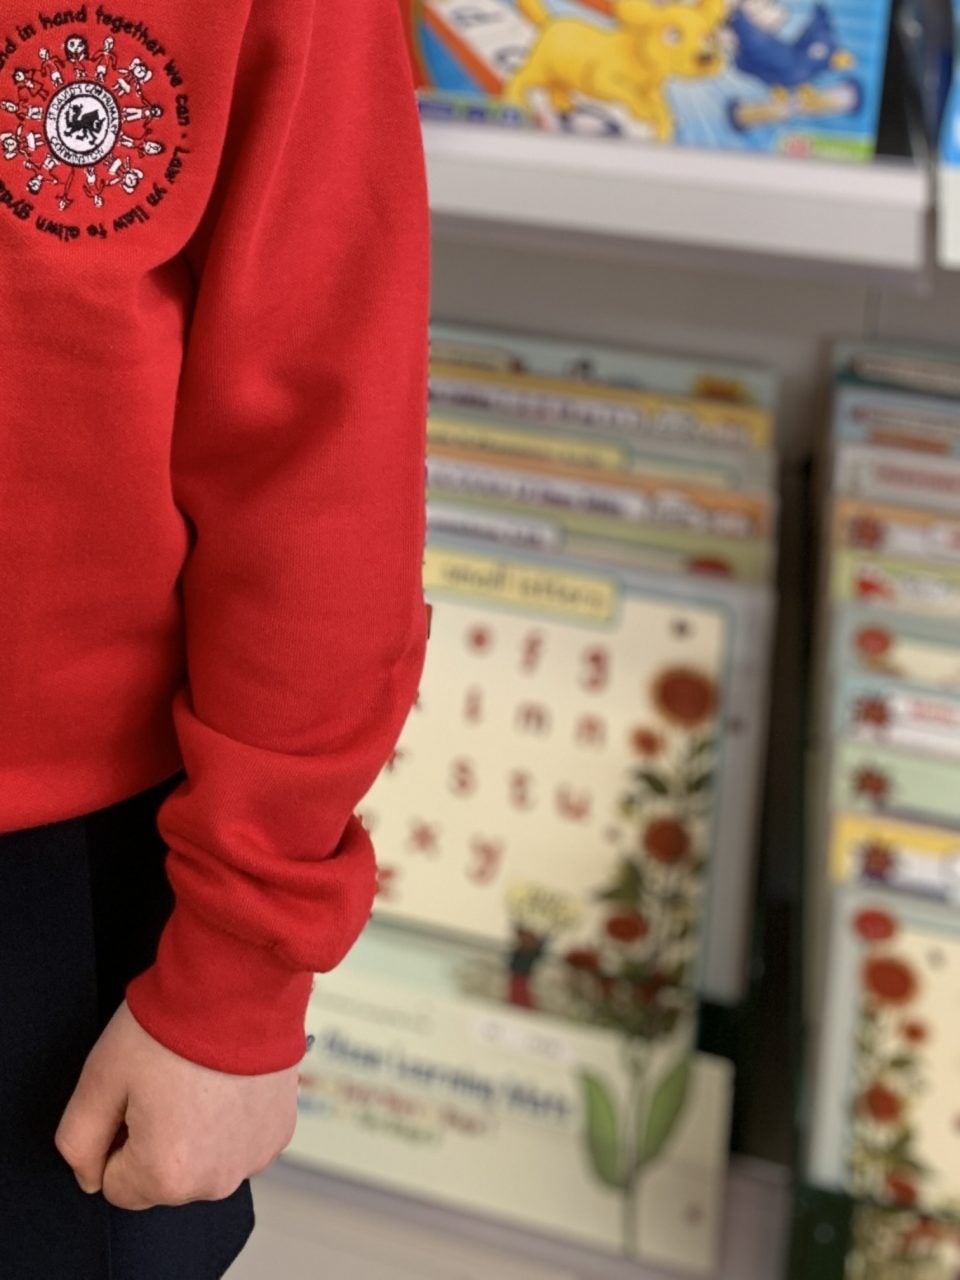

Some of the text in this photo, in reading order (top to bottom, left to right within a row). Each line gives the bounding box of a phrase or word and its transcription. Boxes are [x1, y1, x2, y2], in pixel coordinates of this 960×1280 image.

[16, 22, 37, 42] in
[39, 4, 88, 30] hand
[95, 4, 166, 57] together
[163, 59, 183, 88] we
[175, 93, 191, 127] can
